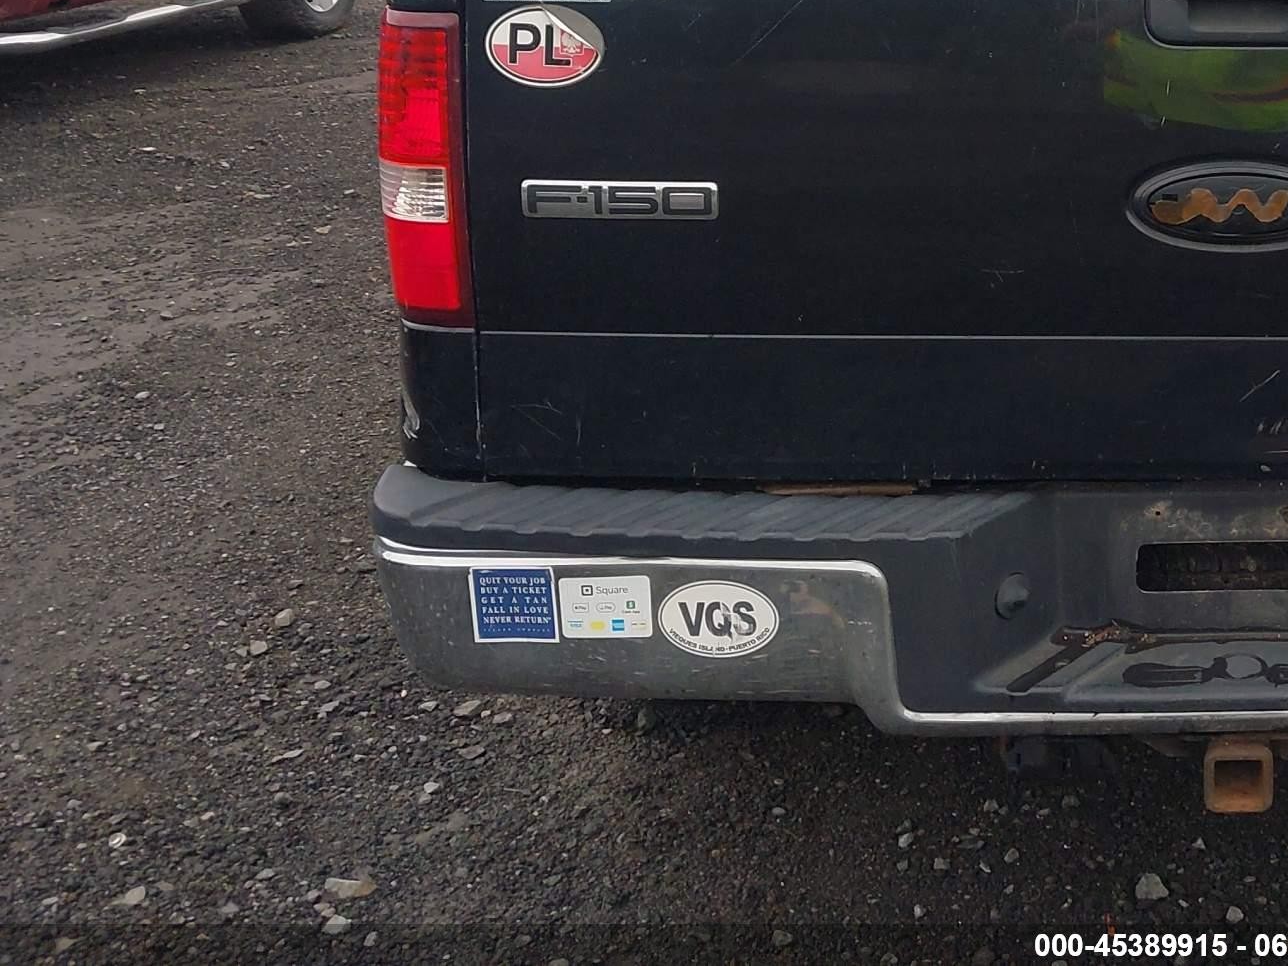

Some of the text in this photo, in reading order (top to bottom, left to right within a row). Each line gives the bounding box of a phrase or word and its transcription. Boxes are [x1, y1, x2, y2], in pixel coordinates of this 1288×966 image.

[508, 22, 571, 66] PL
[525, 184, 713, 215] F-150
[480, 577, 546, 586] QUIT YOUR JOB
[595, 586, 629, 596] Square
[481, 596, 548, 604] GET A TAN
[482, 606, 549, 614] FALL IN LOVE
[483, 616, 512, 624] NEVER
[678, 601, 757, 639] VQS
